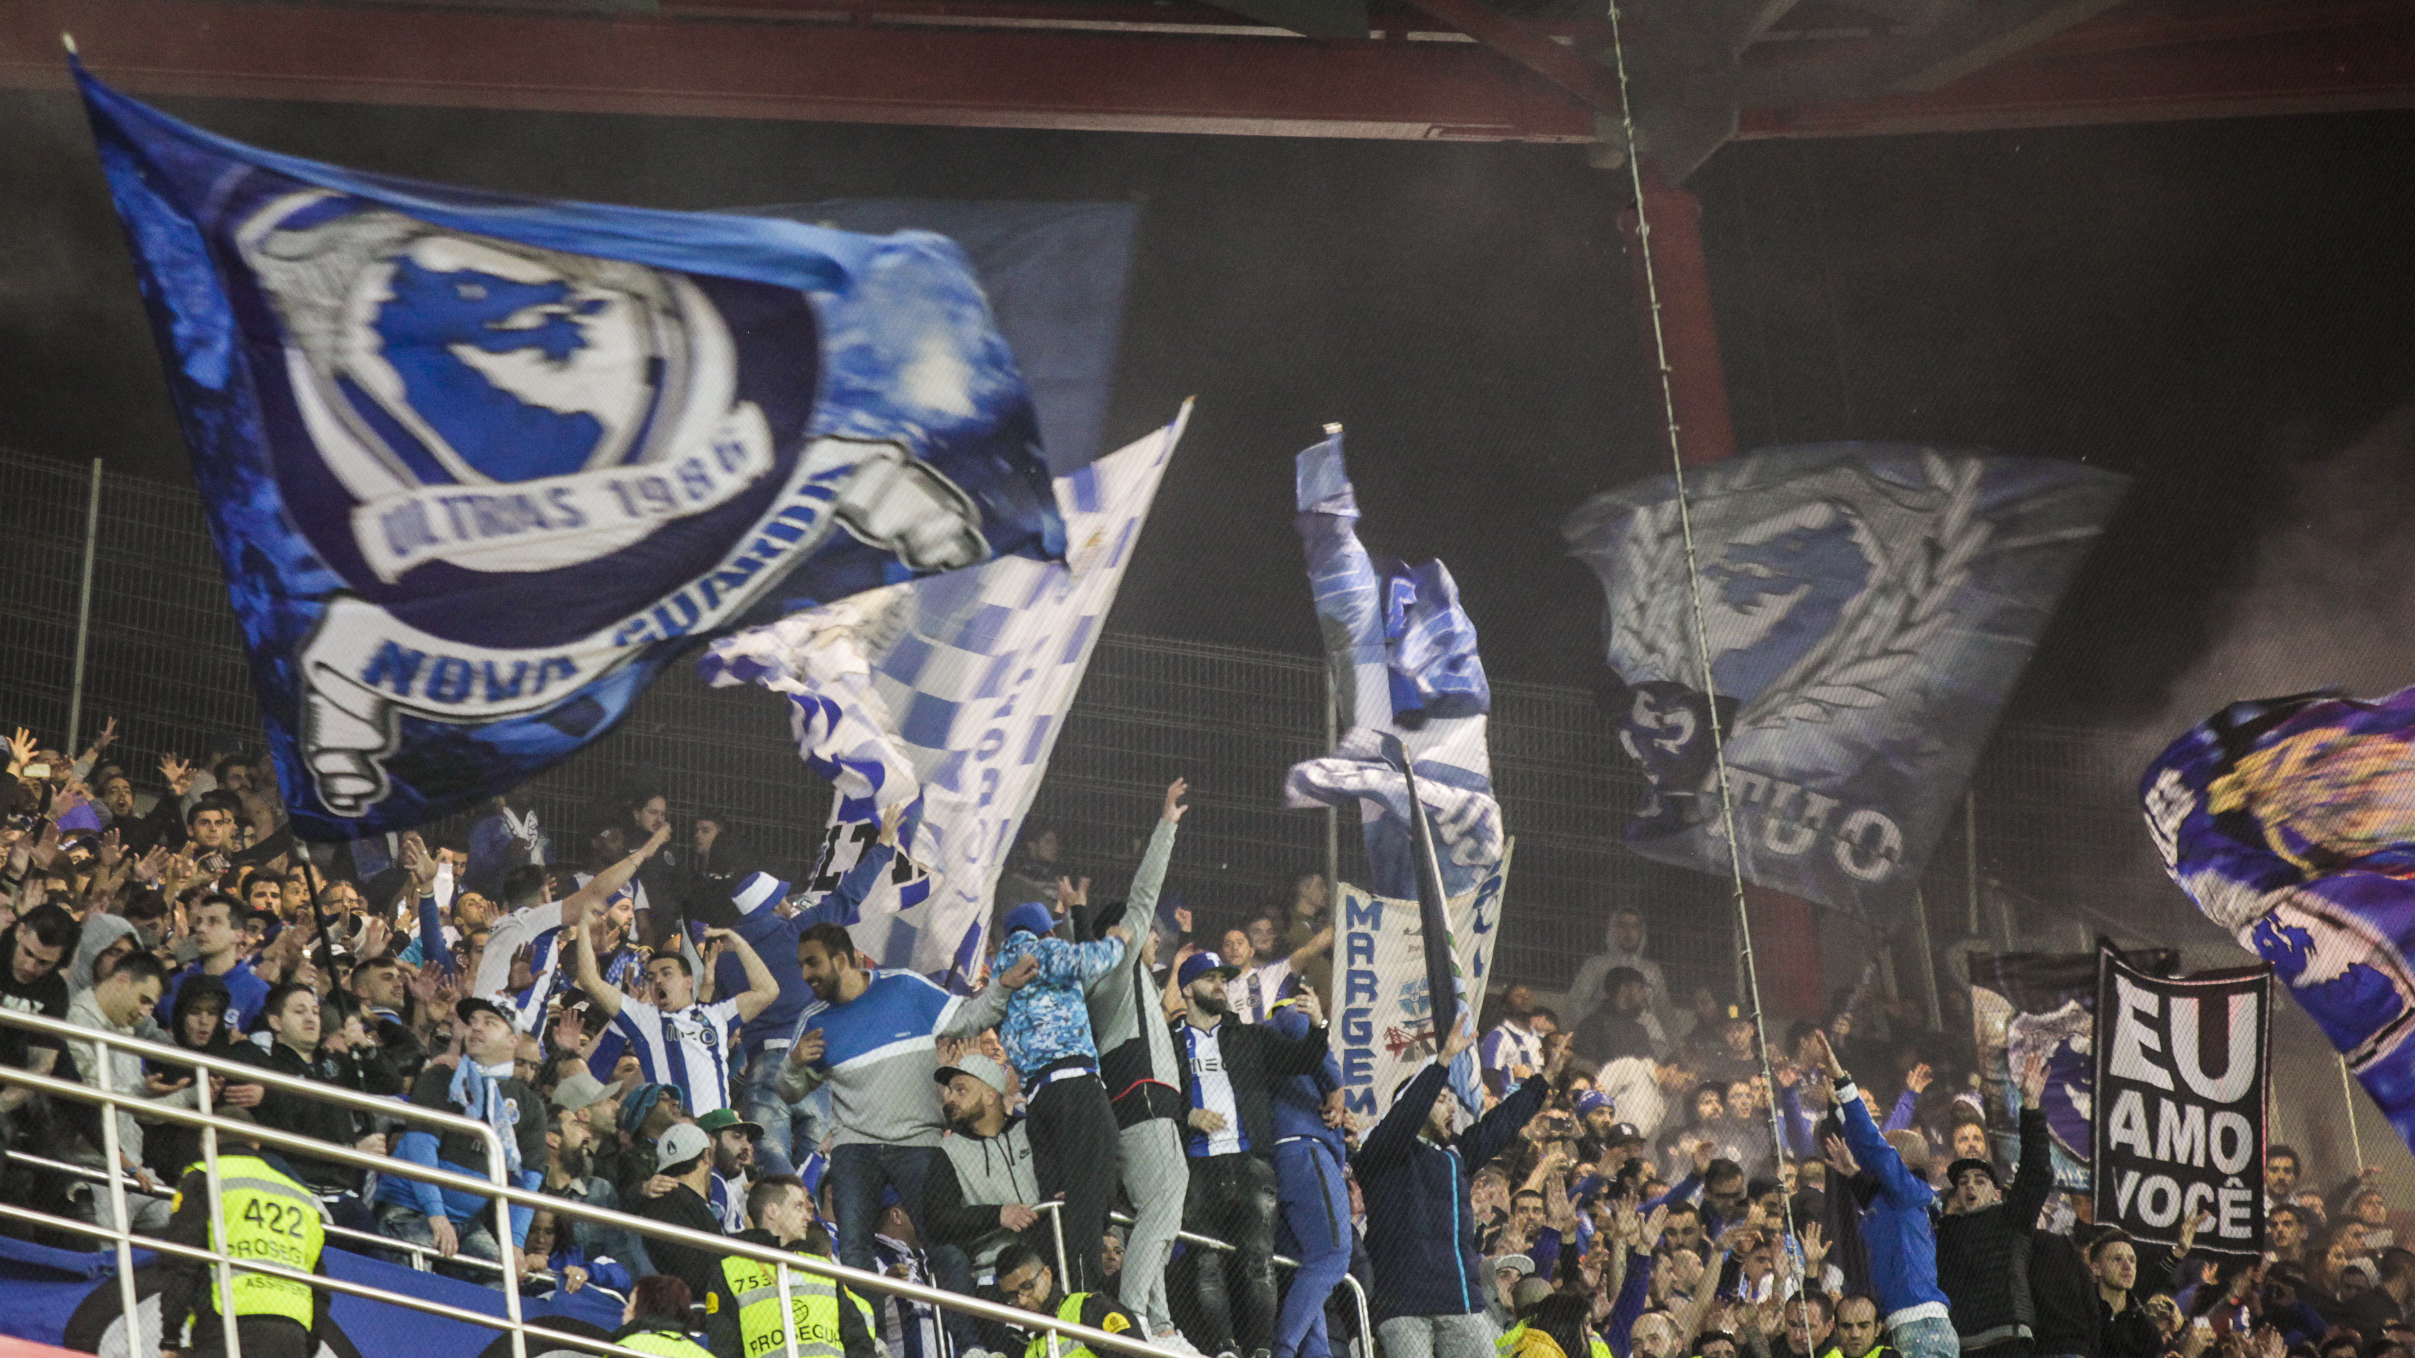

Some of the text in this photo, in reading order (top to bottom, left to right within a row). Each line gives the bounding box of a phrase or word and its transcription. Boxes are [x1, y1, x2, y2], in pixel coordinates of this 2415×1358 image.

[380, 485, 588, 557] ULTRAS
[360, 462, 858, 703] NOVA GUARDA
[1341, 894, 1384, 1117] MARGEM
[2109, 973, 2258, 1104] EU
[2109, 1089, 2253, 1175] AMO
[244, 1198, 304, 1240] 422
[2112, 1166, 2253, 1239] VOCÊ
[749, 1324, 842, 1356] PROEGU
